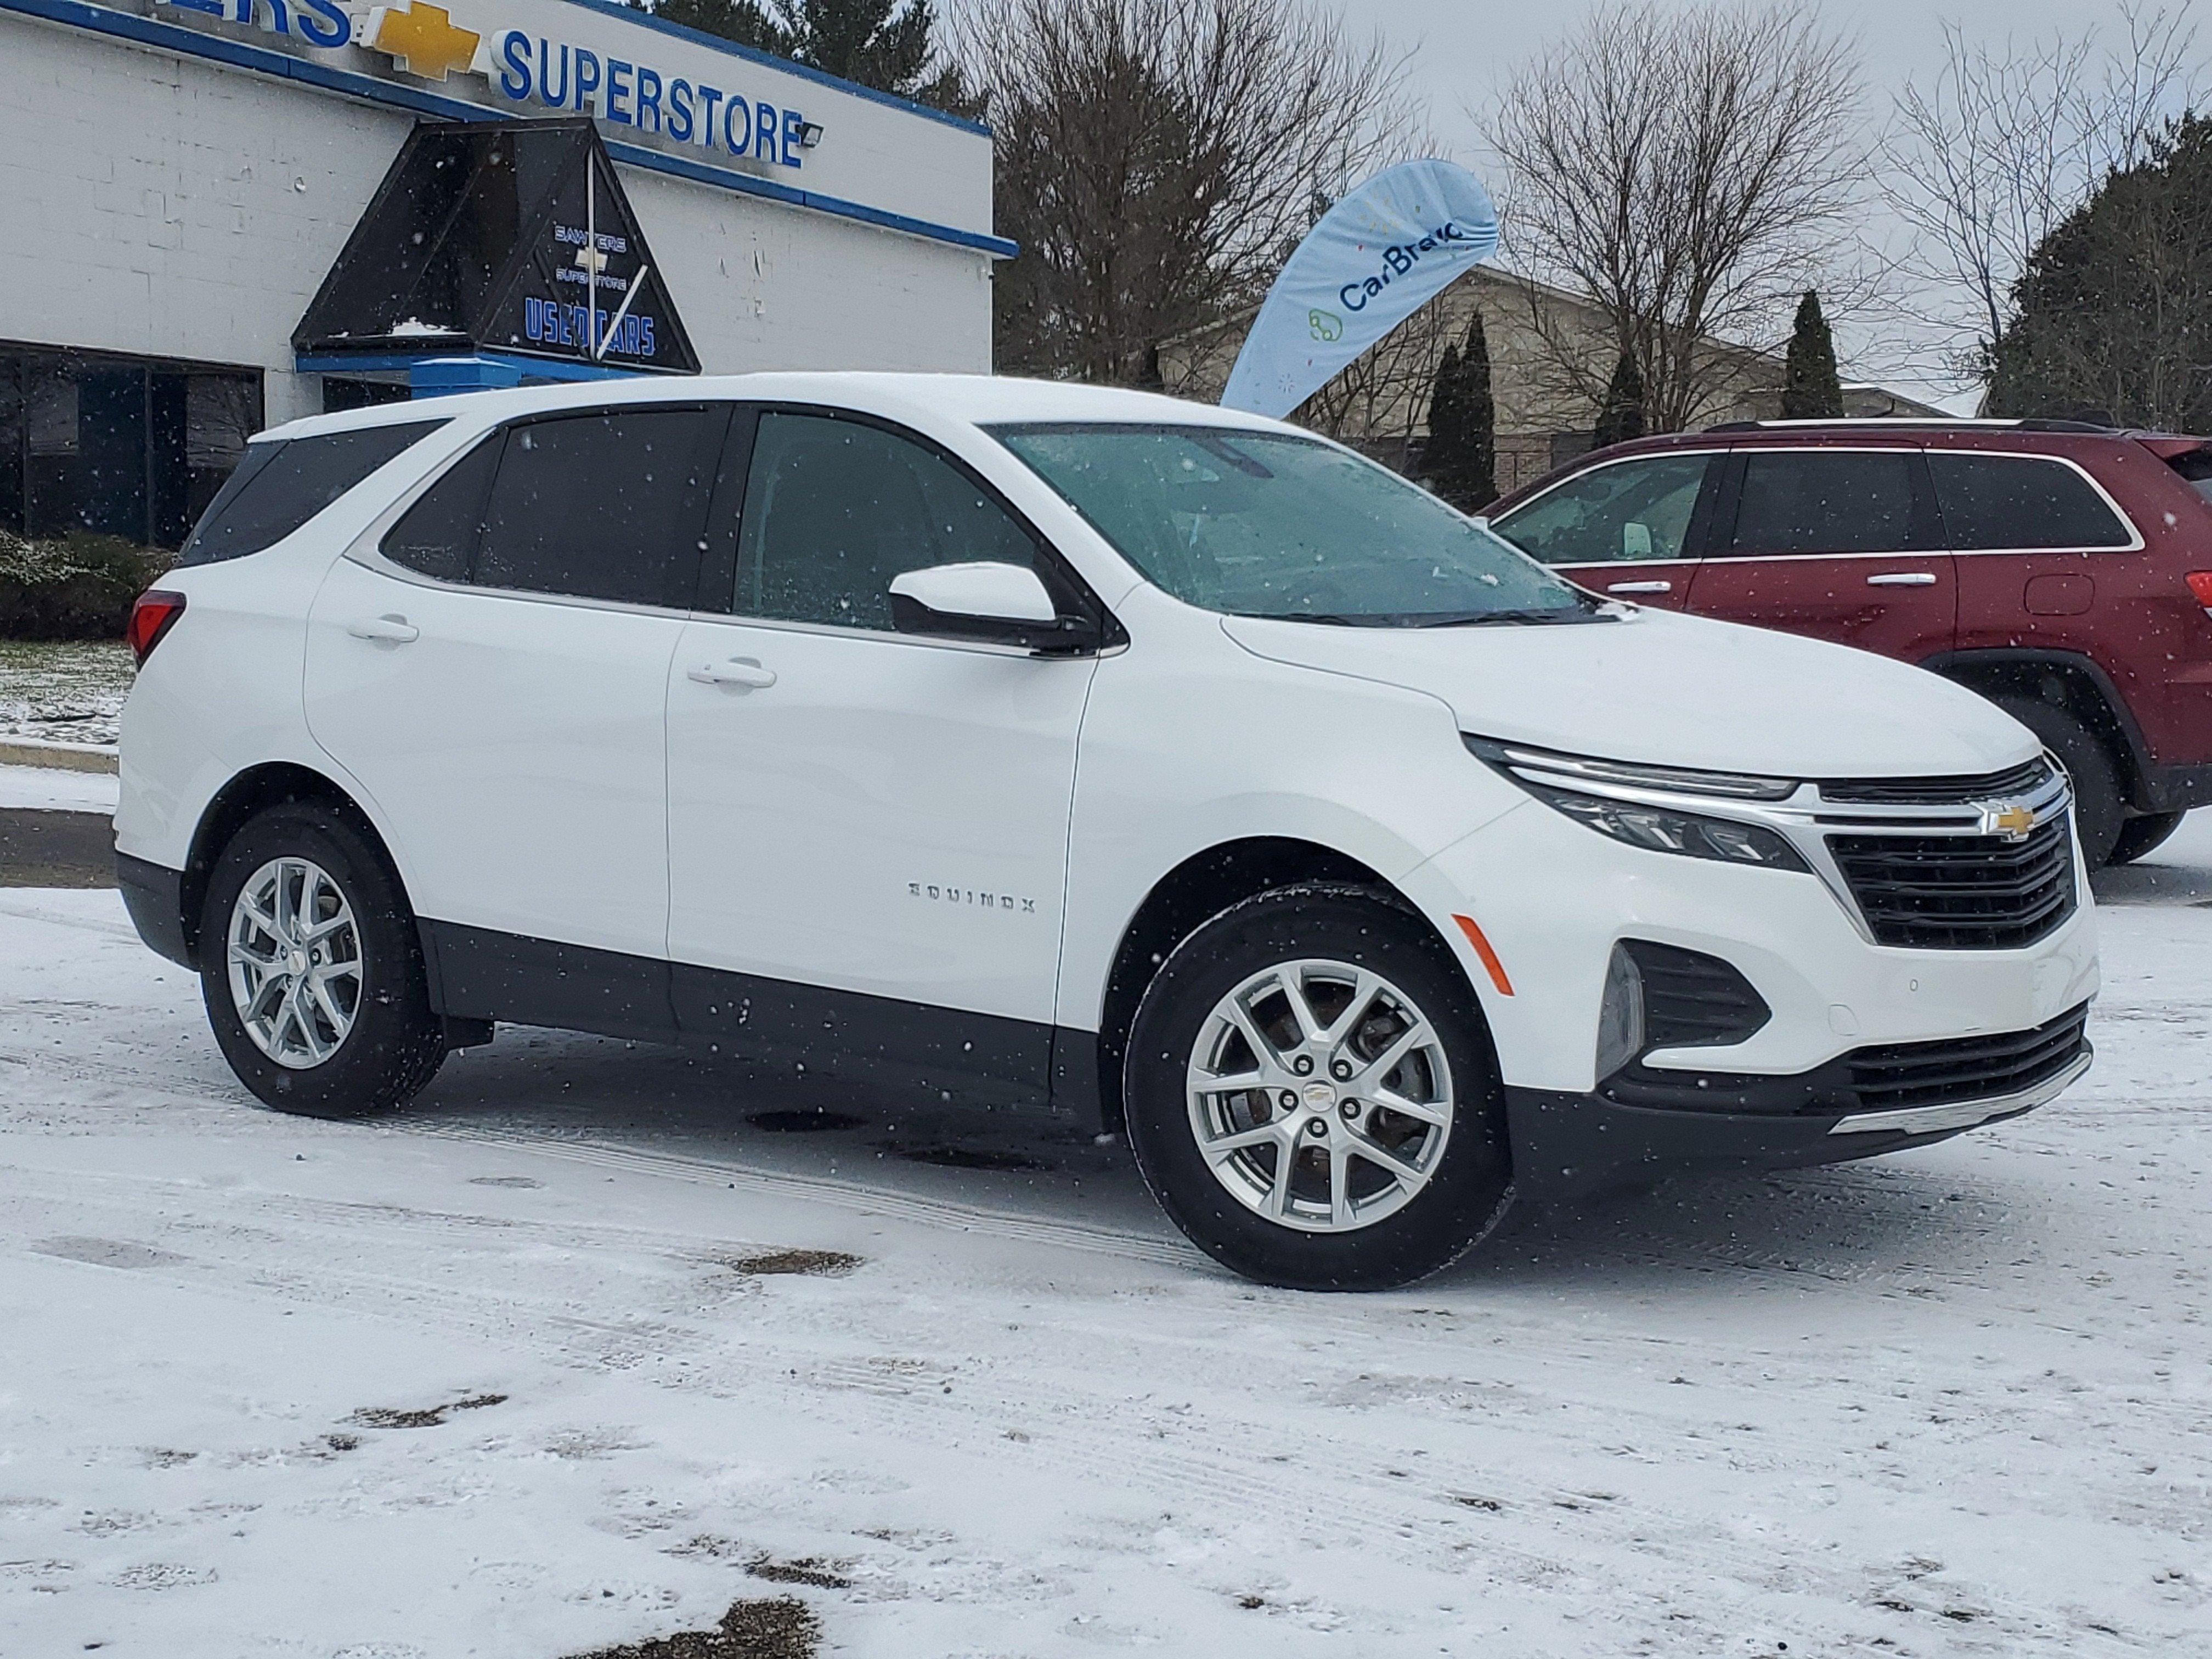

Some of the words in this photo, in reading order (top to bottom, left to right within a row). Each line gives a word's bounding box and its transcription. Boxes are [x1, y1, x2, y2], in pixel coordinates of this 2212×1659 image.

[499, 30, 802, 169] SUPERSTORE
[554, 225, 627, 253] SAWERS
[555, 268, 627, 291] SUPETORE
[525, 297, 590, 348] USED
[909, 883, 1035, 913] EQUINOX
